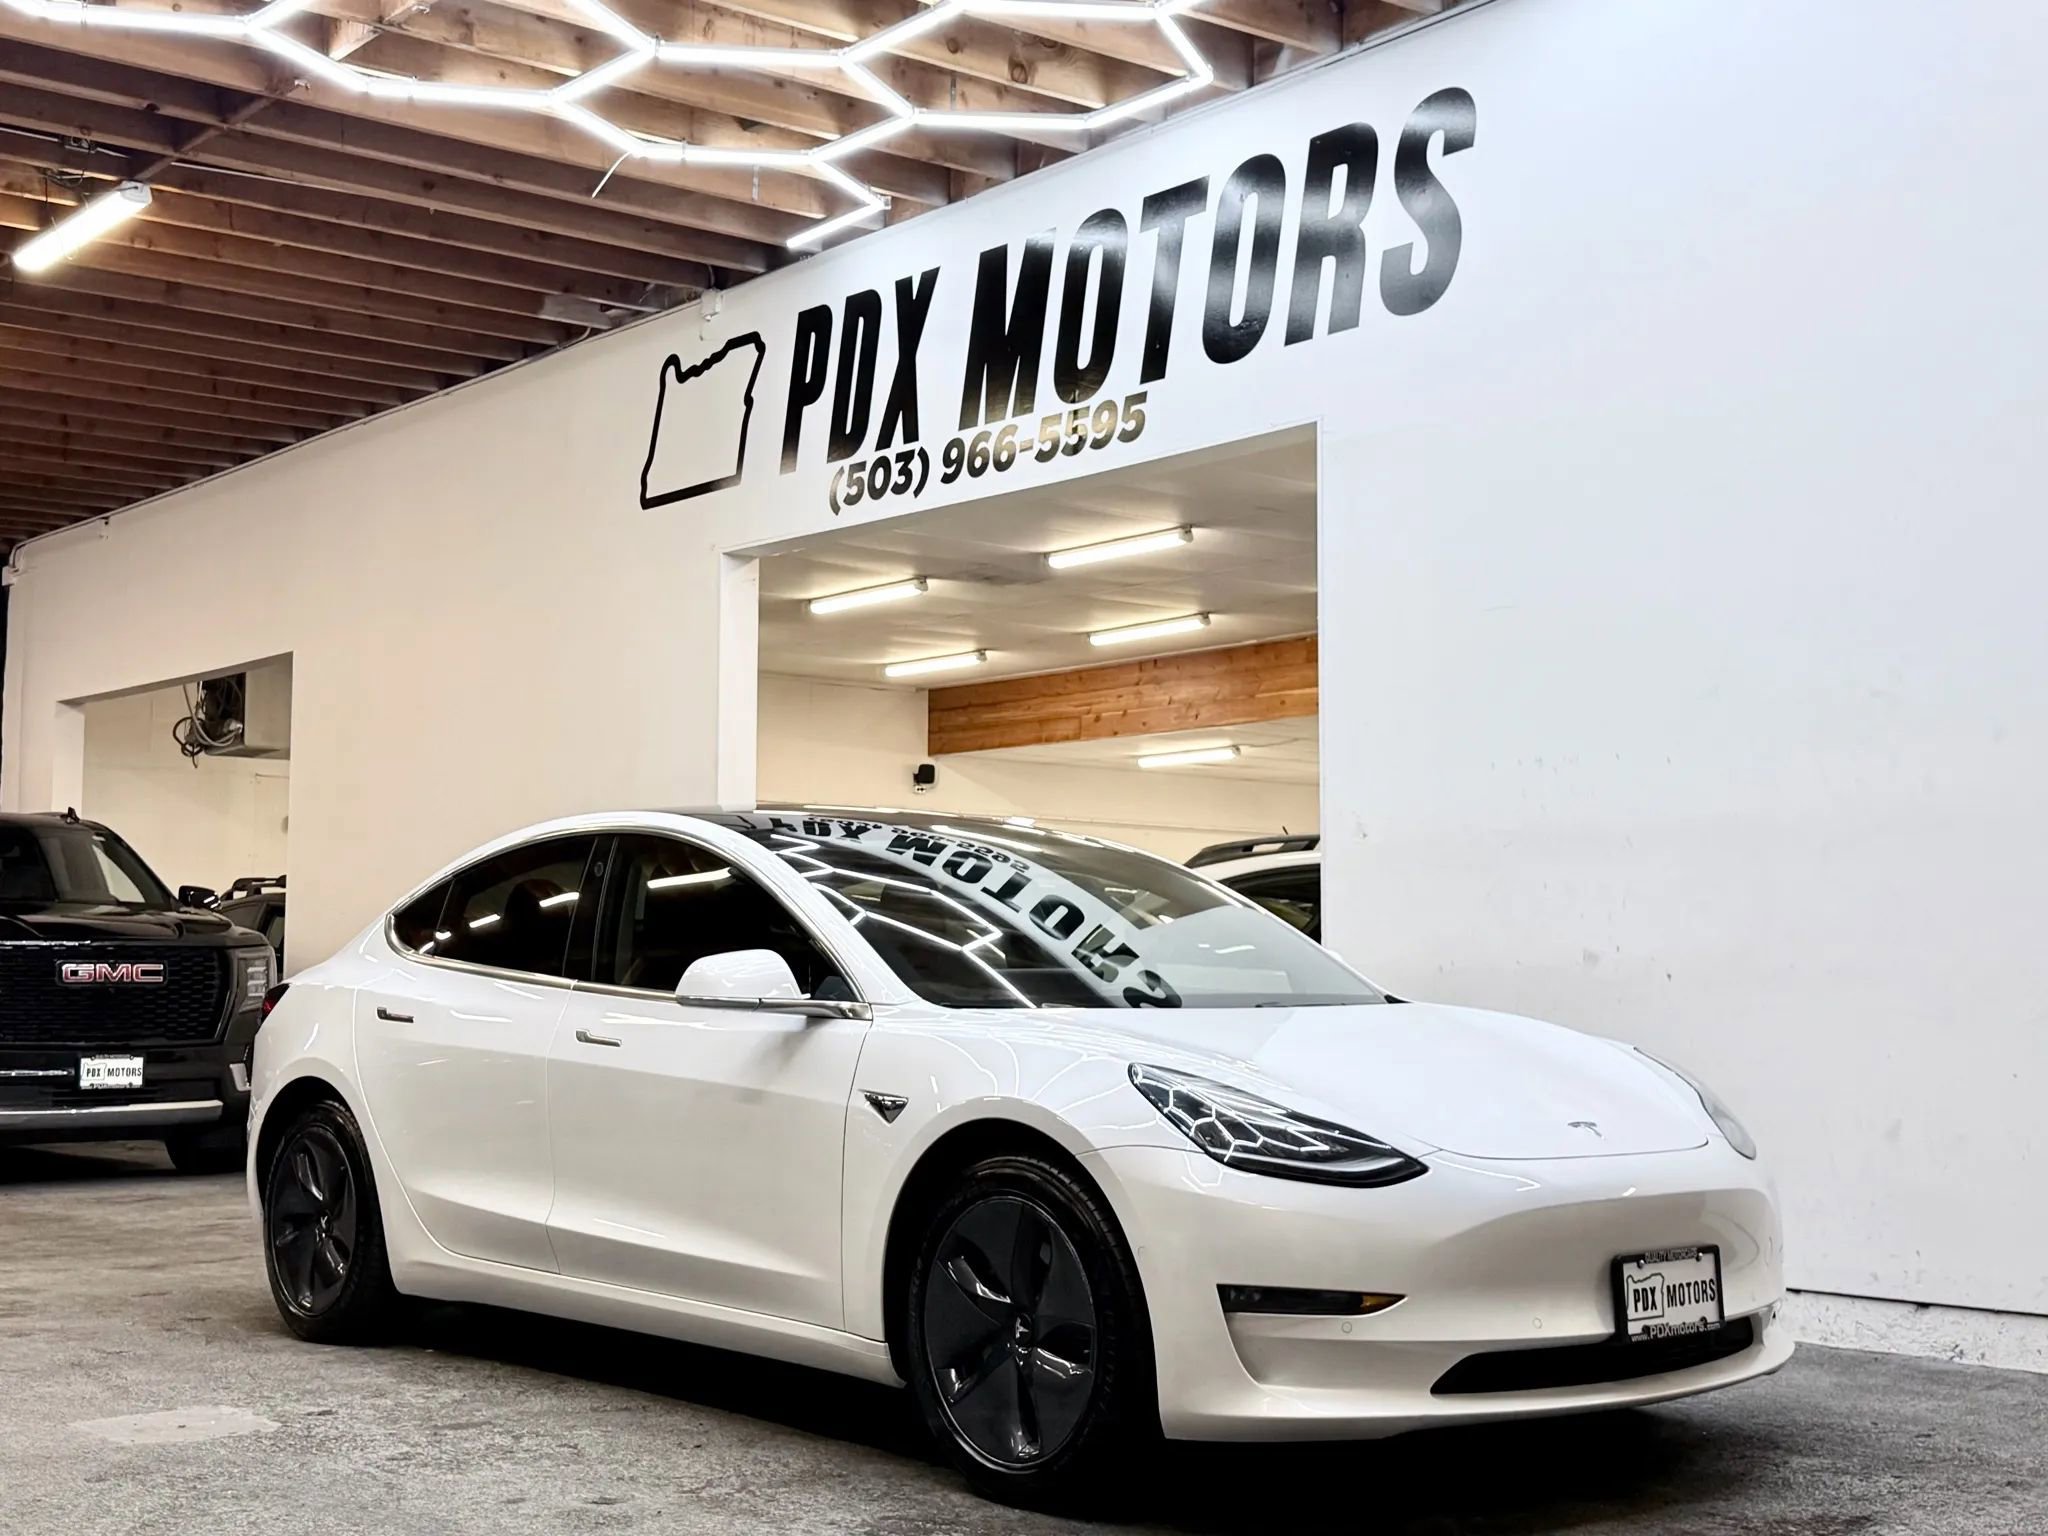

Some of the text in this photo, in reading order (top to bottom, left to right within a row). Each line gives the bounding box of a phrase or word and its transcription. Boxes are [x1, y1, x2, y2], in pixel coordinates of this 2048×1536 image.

[779, 86, 1477, 475] PDX MOTORS
[829, 390, 1148, 516] (503) 966-5595
[62, 963, 164, 983] GMC
[86, 1067, 142, 1078] PDX MOTORS
[1633, 1278, 1716, 1313] PDX MOTORS
